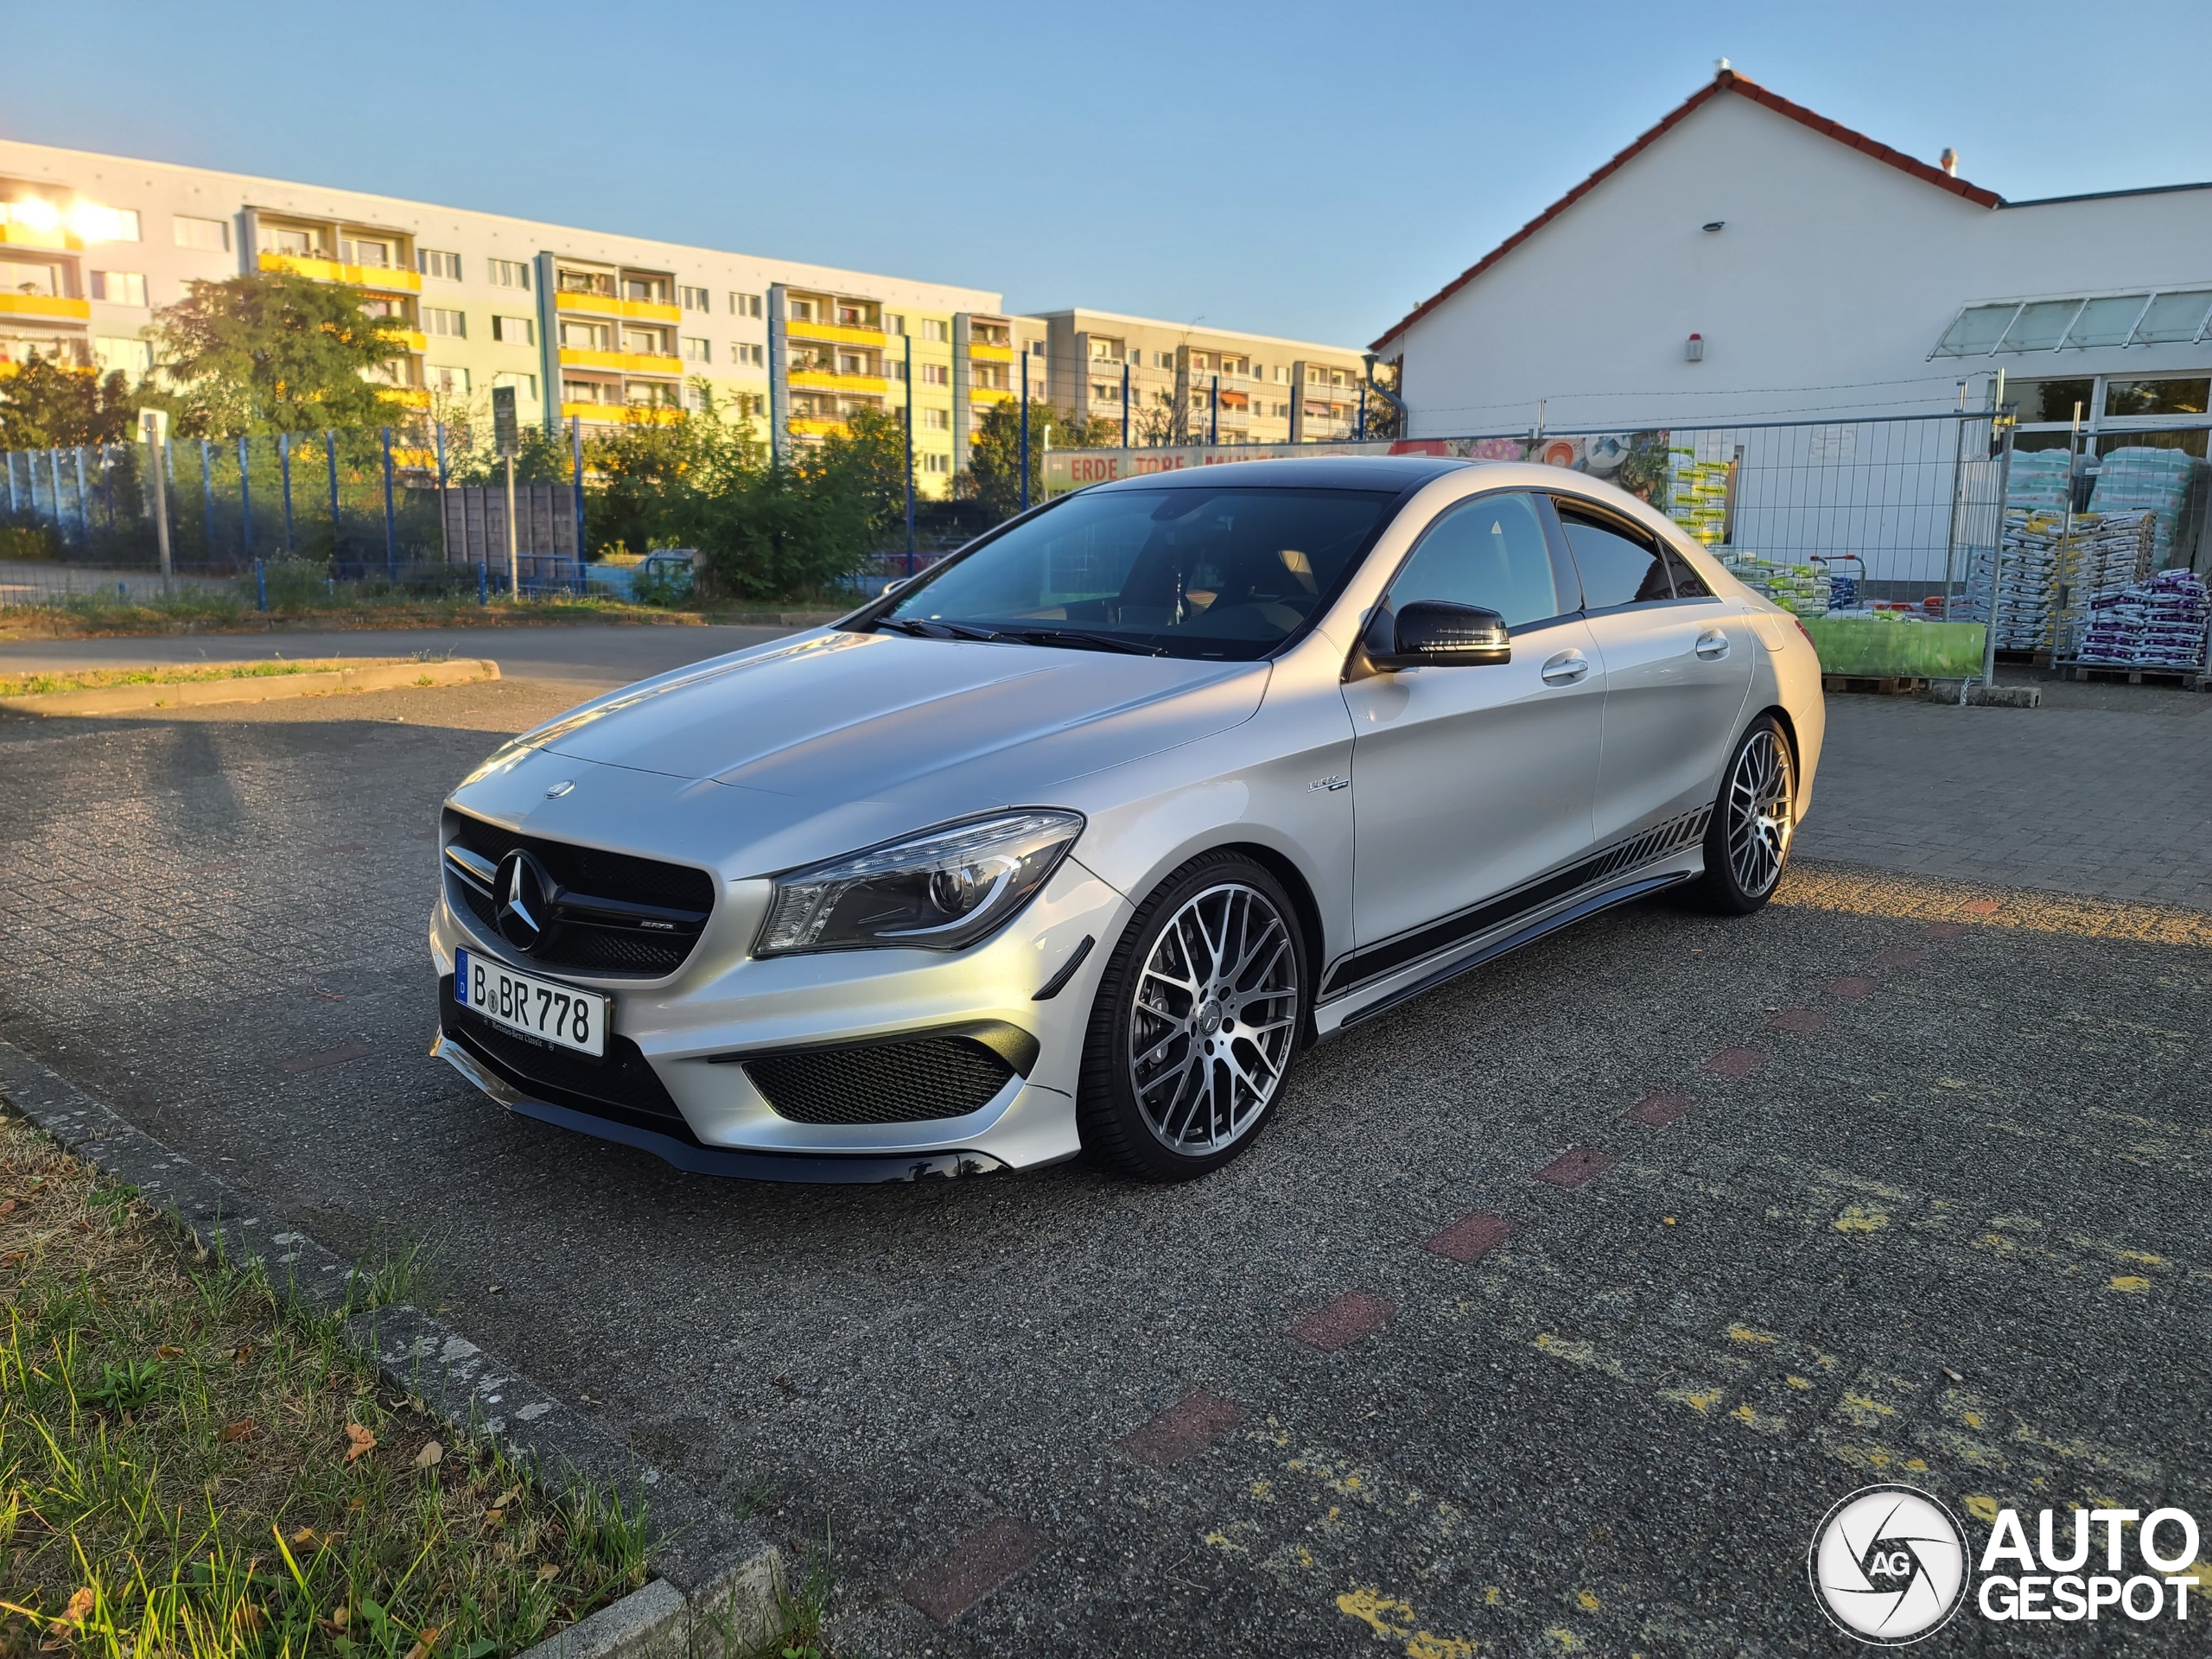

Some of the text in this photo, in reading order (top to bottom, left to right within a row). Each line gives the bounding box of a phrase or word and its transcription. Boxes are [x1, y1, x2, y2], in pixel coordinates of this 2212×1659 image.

[1071, 458, 1117, 481] ERDE
[460, 982, 465, 994] D
[474, 963, 589, 1044] B BR 778
